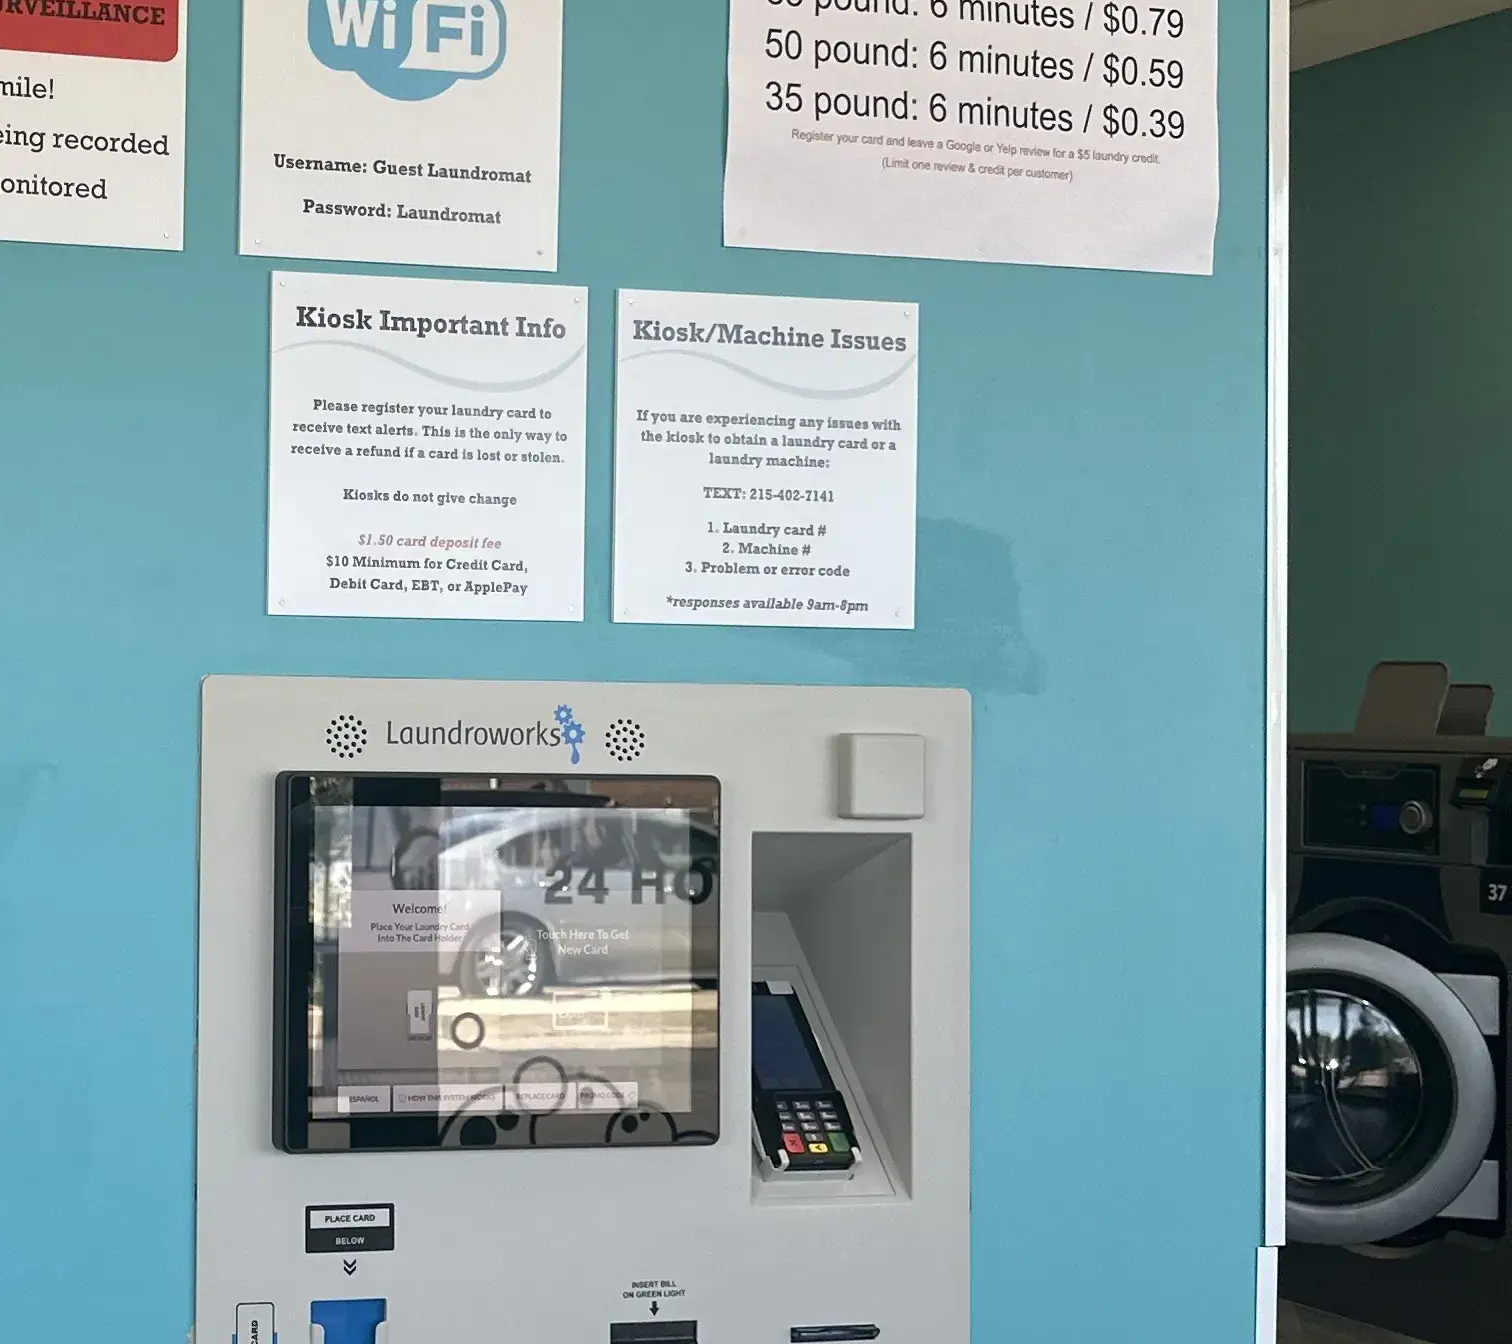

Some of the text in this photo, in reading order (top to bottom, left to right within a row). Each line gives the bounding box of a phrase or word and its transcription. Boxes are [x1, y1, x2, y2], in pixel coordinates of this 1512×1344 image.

[765, 80, 1185, 140] 35 pound: 6 minutes / $0.39
[52, 132, 170, 156] recorded
[273, 153, 532, 184] Username: Guest Laundromat
[302, 198, 502, 225] Password: Laundromat
[295, 305, 566, 339] Kiosk Important Info
[632, 319, 907, 352] Kiosk/Machine Issues
[702, 486, 834, 503] TEXT: 215-402-7141
[387, 719, 561, 747] Laundroworks
[1488, 884, 1507, 901] 37
[324, 1213, 376, 1224] PLACE CARD
[336, 1236, 365, 1245] BELOW
